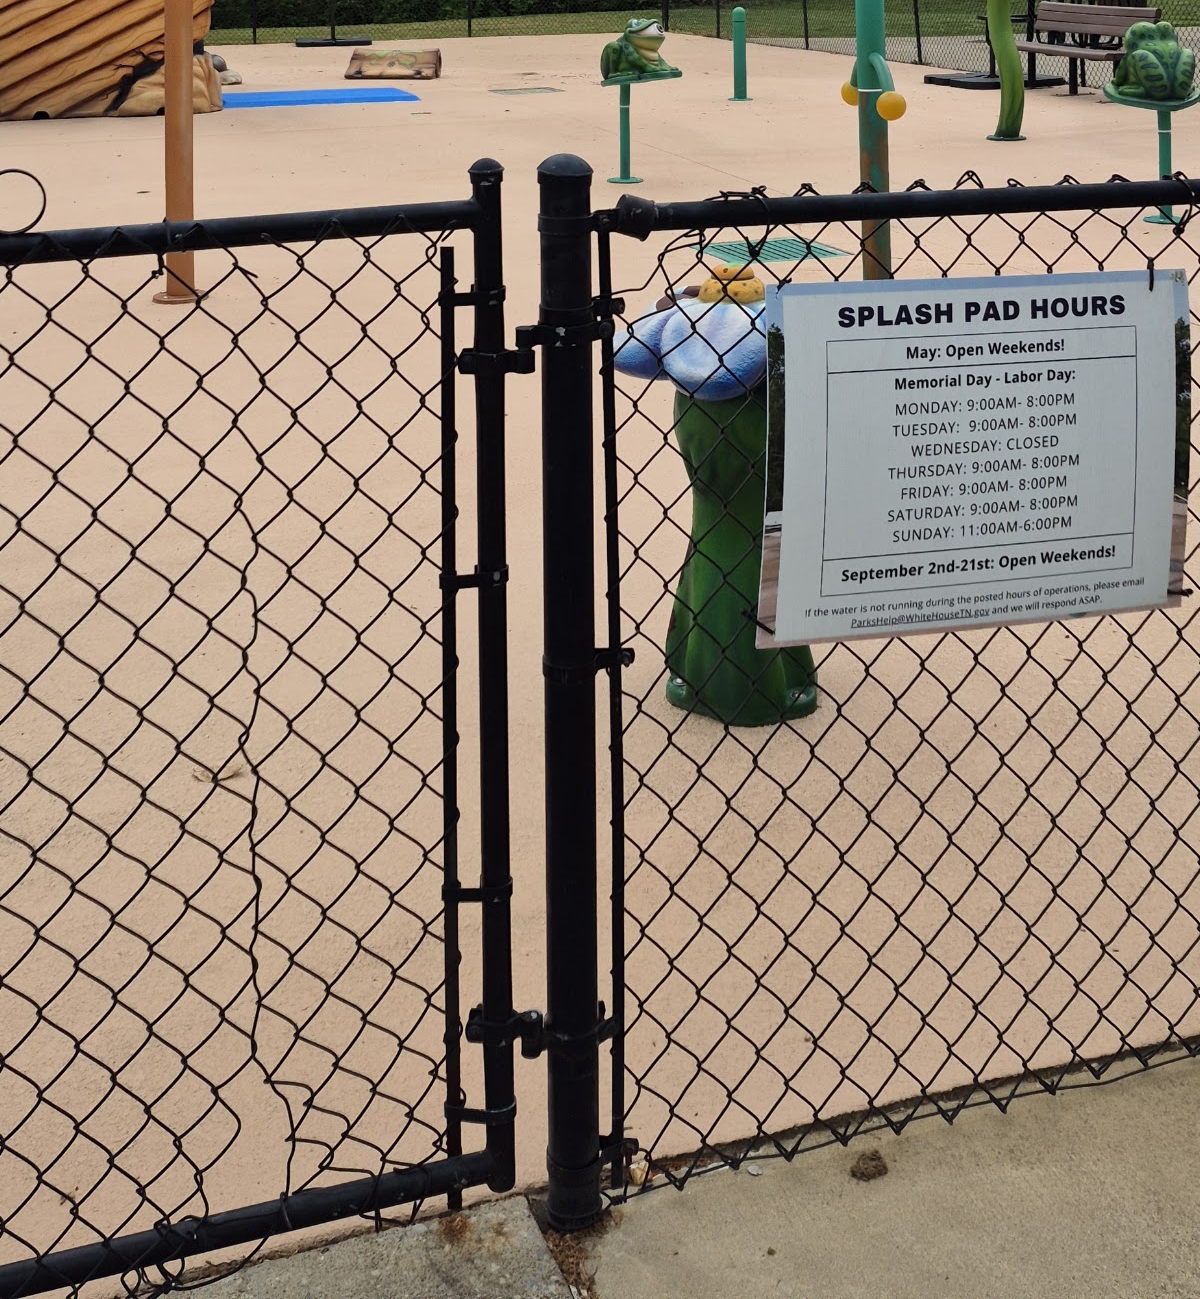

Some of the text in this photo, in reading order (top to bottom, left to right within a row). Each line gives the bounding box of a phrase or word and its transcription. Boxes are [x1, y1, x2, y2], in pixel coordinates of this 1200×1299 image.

[838, 295, 1125, 328] SPLASH PAD HOURS
[907, 339, 1064, 362] May: Open Weekends!
[895, 374, 961, 390] Memorial
[966, 374, 992, 388] Day
[1005, 370, 1043, 384] Labor
[1047, 369, 1075, 383] Day:
[896, 393, 1074, 416] MONDAY: 9:00AM- 8:00PM
[892, 413, 1076, 437] TUESDAY: 9:00AM- 8:00PM
[911, 435, 1059, 457] WEDNESDAY: CLOSED
[888, 454, 1079, 480] THURSDAY: 9:00AM- 8:00PM
[901, 475, 1067, 500] FRIDAY: 9:00AM- 8:00PM
[888, 495, 1078, 522] SATURDAY: 9:00AM- 8:00PM
[893, 516, 1072, 543] SUNDAY: 11:00AM-6:00PM
[841, 545, 1115, 584] September 2nd-21st: Open Weekends!
[805, 576, 1145, 618] If the water is not running during the posted hours of operations, please email
[850, 594, 1102, 628] ParksHelp@WhiteHouseTN.gov and we will respond ASAP.
